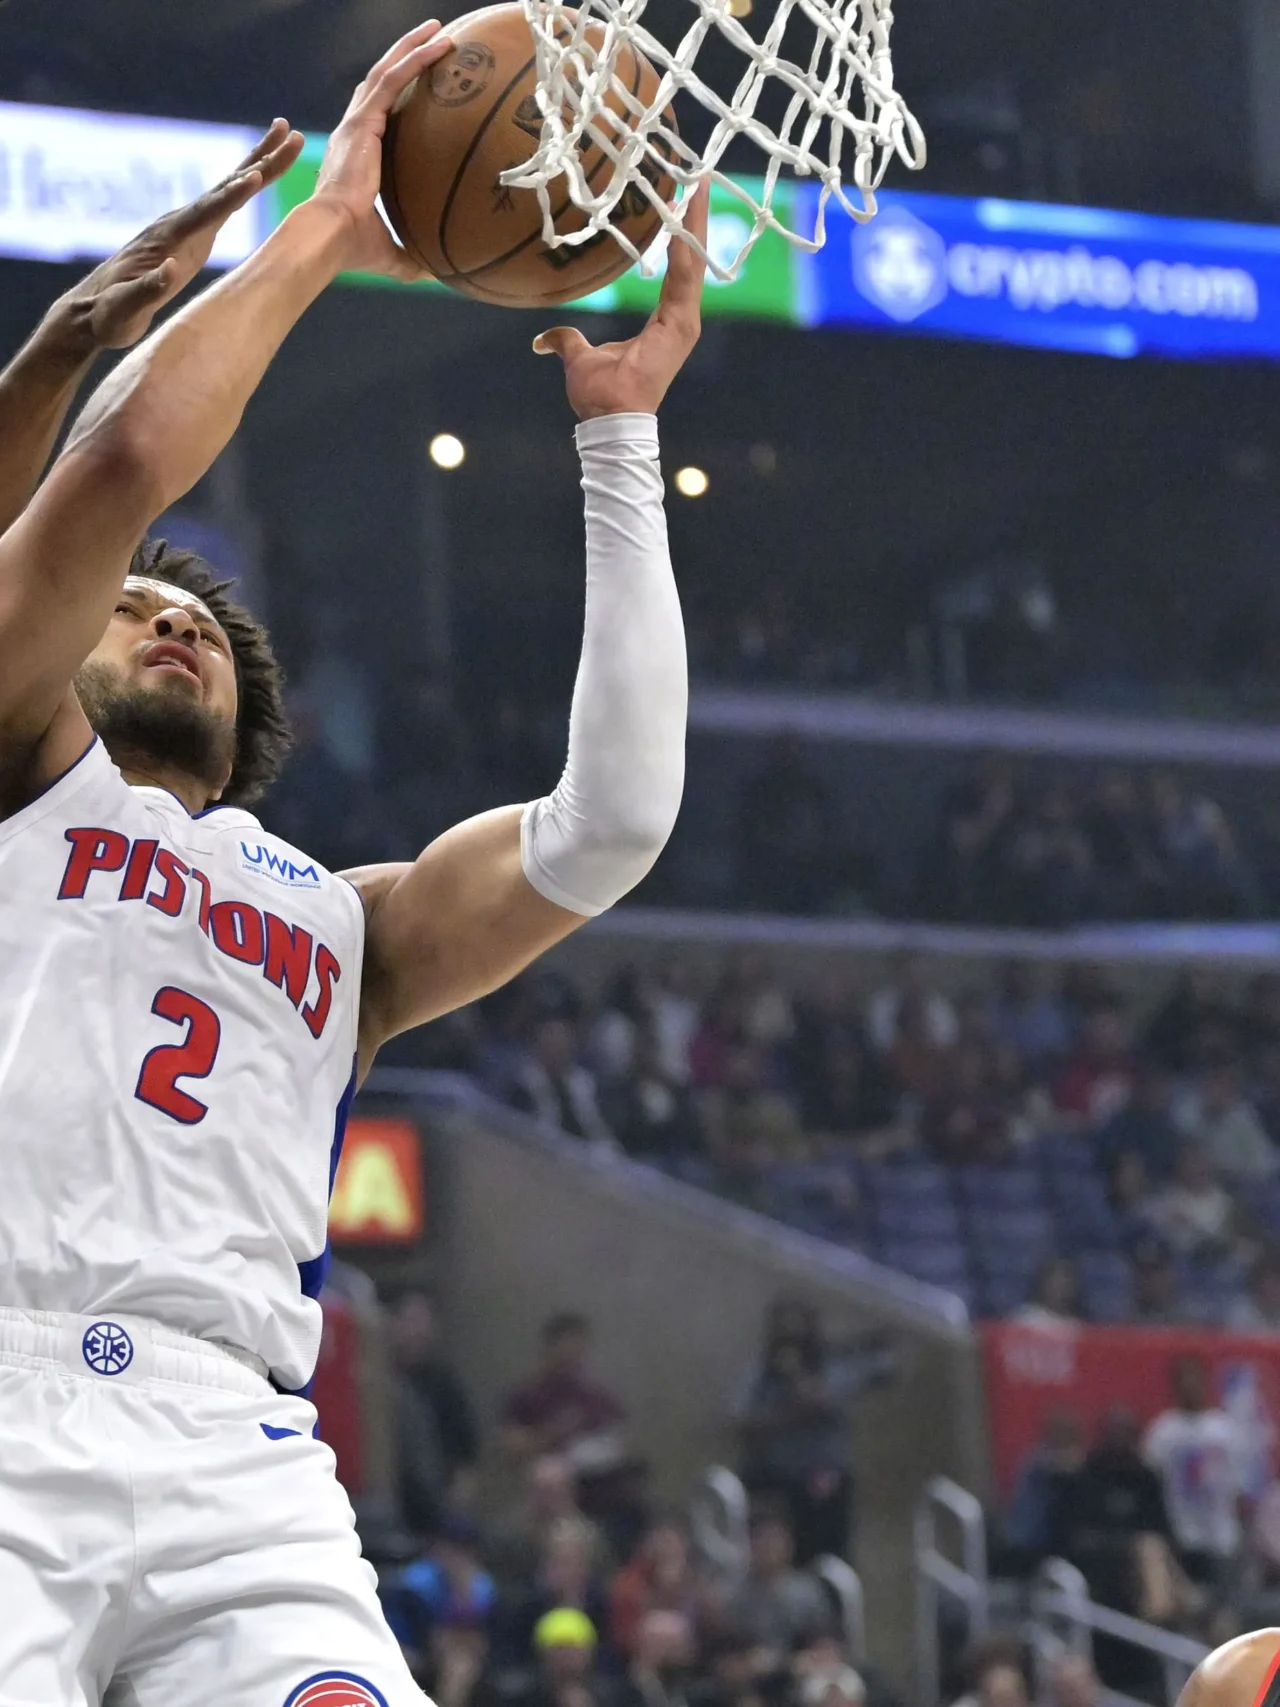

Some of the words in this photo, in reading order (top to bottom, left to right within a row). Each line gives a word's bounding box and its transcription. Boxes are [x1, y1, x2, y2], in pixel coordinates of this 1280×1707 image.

[947, 242, 1259, 322] crypto.com
[240, 841, 320, 881] UWM
[134, 986, 220, 1125] 2
